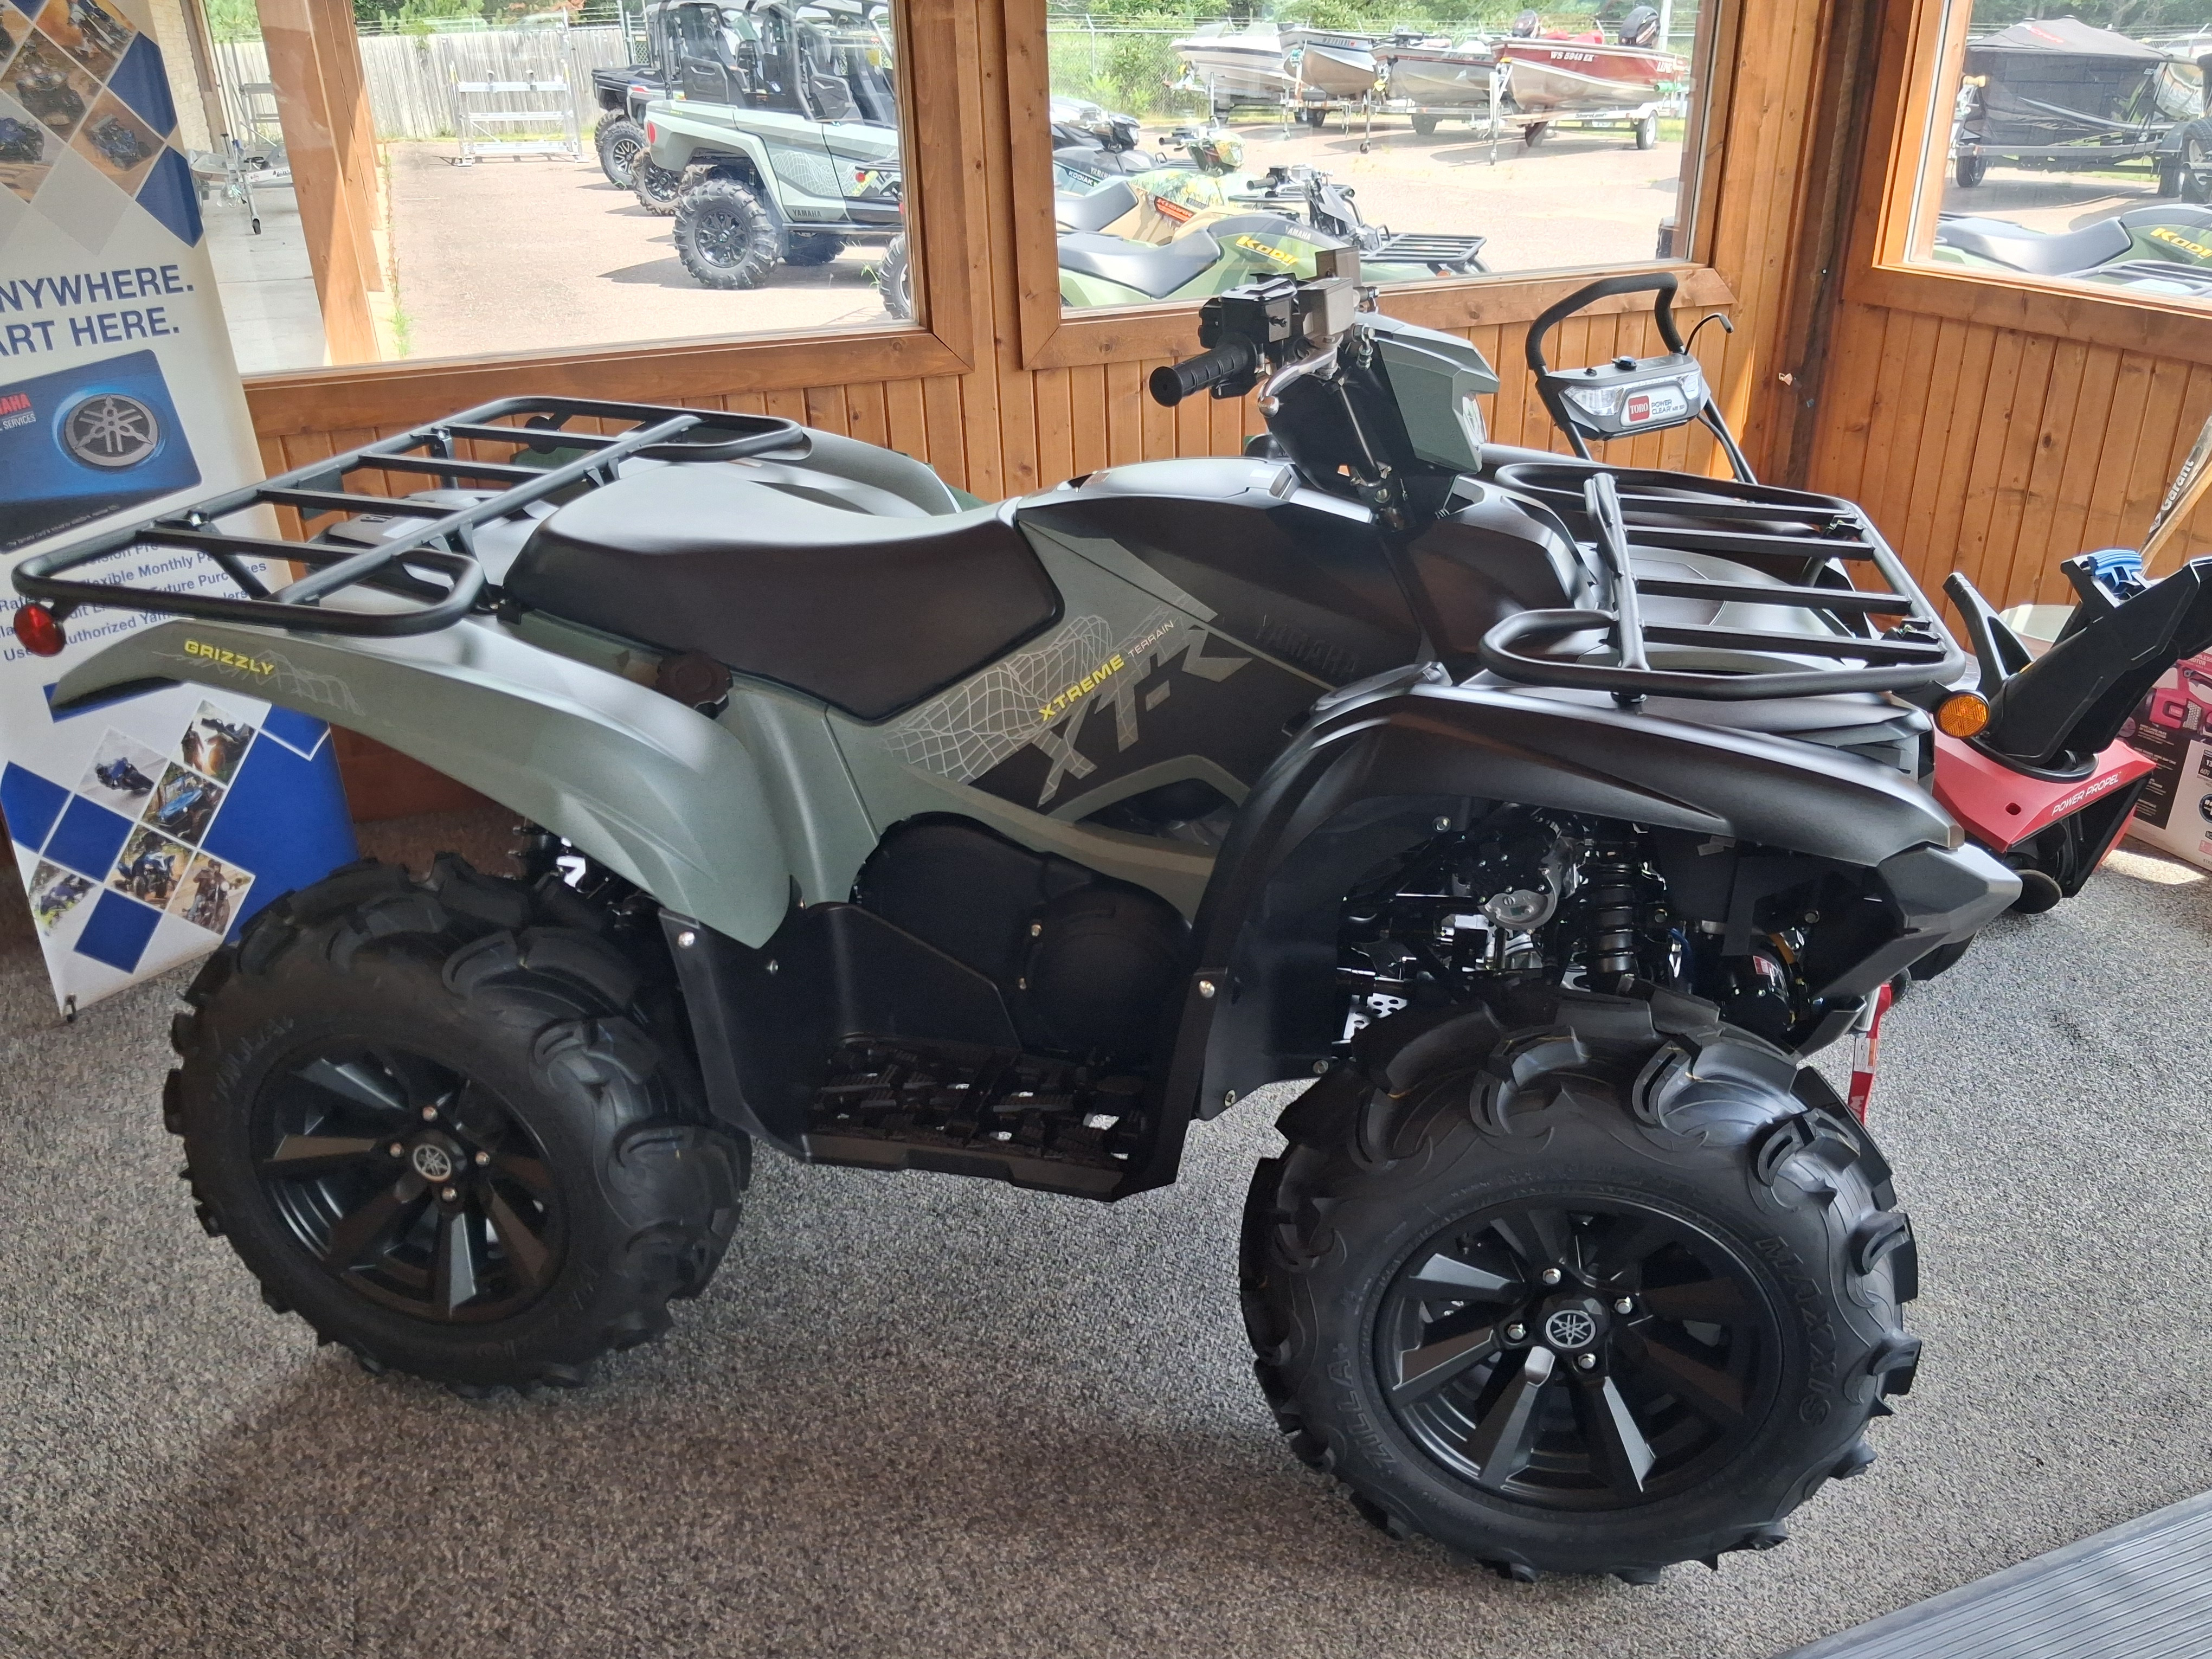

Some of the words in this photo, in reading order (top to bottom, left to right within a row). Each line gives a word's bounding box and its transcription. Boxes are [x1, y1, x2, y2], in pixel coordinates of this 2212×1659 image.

[1656, 61, 1674, 74] LUN
[1068, 170, 1094, 186] KODIAK
[792, 209, 822, 218] YAMAHA
[1156, 198, 1193, 217] KODIAK
[1285, 225, 1311, 241] YAMAHA
[69, 307, 179, 347] HERE.
[0, 393, 31, 415] AHA
[1630, 403, 1649, 415] TORO
[1651, 399, 1672, 408] POWER
[1651, 406, 1671, 415] CLEAR
[3, 413, 36, 430] SERVICES
[2161, 460, 2194, 511] Garant
[138, 556, 193, 577] Monthly
[65, 615, 137, 646] uthorized
[184, 640, 274, 674] GRIZZLY
[1038, 653, 1125, 722] XTREME
[1128, 620, 1174, 658] TERRAIN
[2051, 790, 2085, 816] POWER
[2085, 774, 2119, 798] PROPEL
[1754, 1236, 1840, 1427] MAXXIS
